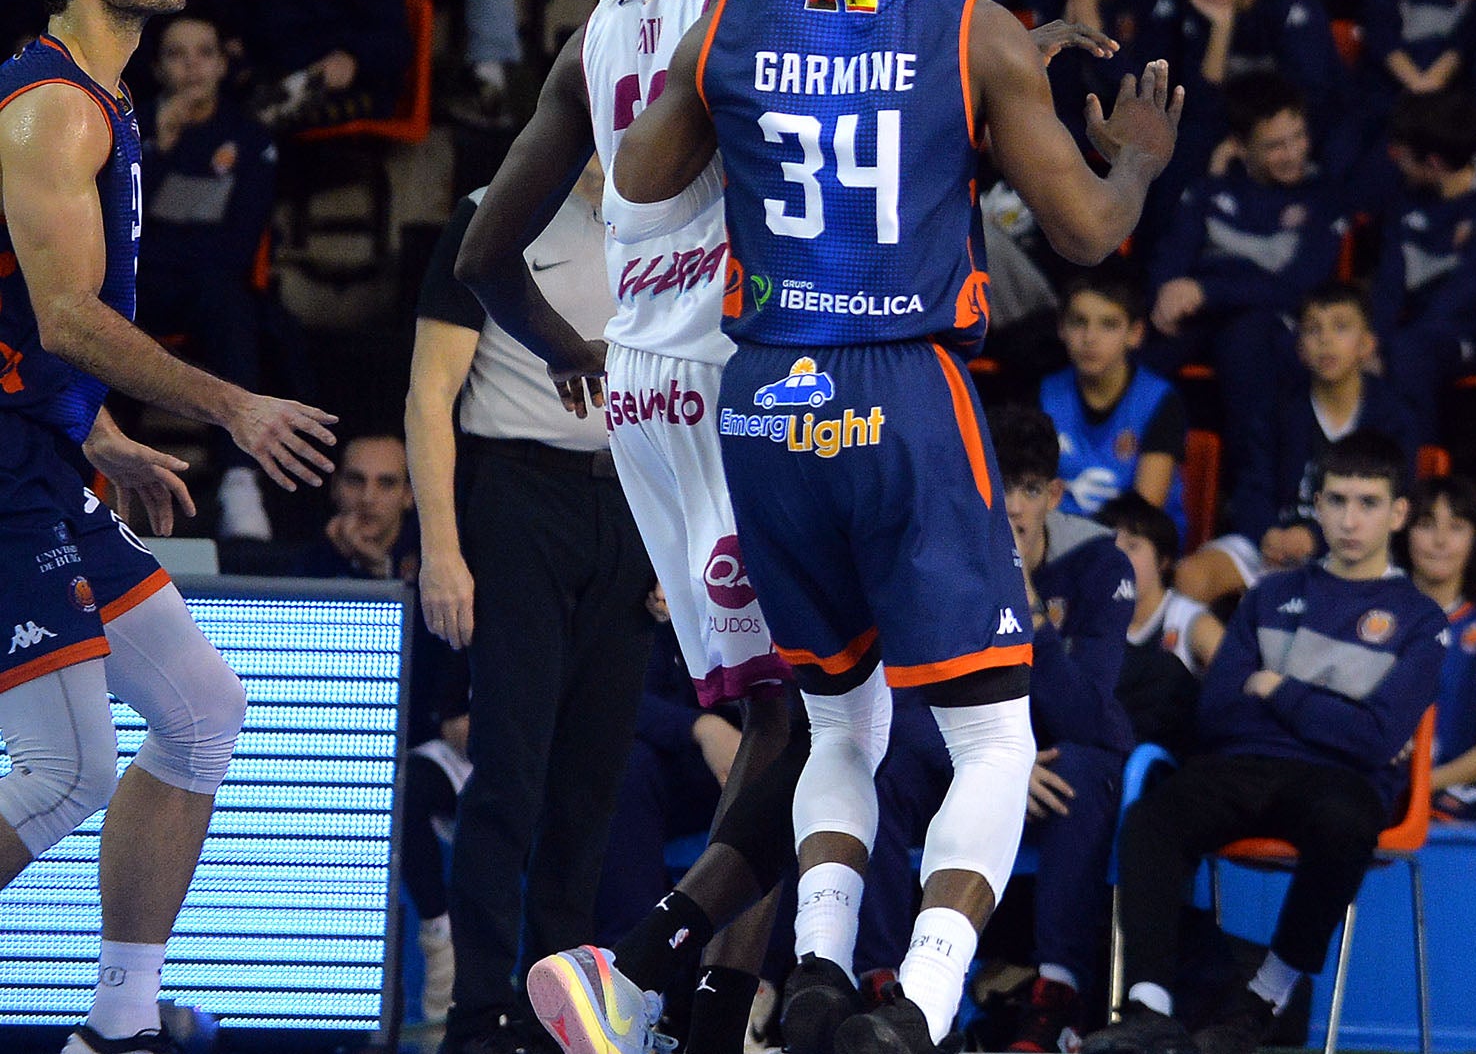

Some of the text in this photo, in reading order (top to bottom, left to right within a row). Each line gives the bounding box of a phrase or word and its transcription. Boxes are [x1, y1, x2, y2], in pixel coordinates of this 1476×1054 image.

[754, 50, 917, 95] GARMINE
[757, 109, 901, 245] 34
[780, 289, 923, 317] IBEREÓLICA
[782, 279, 814, 291] GRUPO
